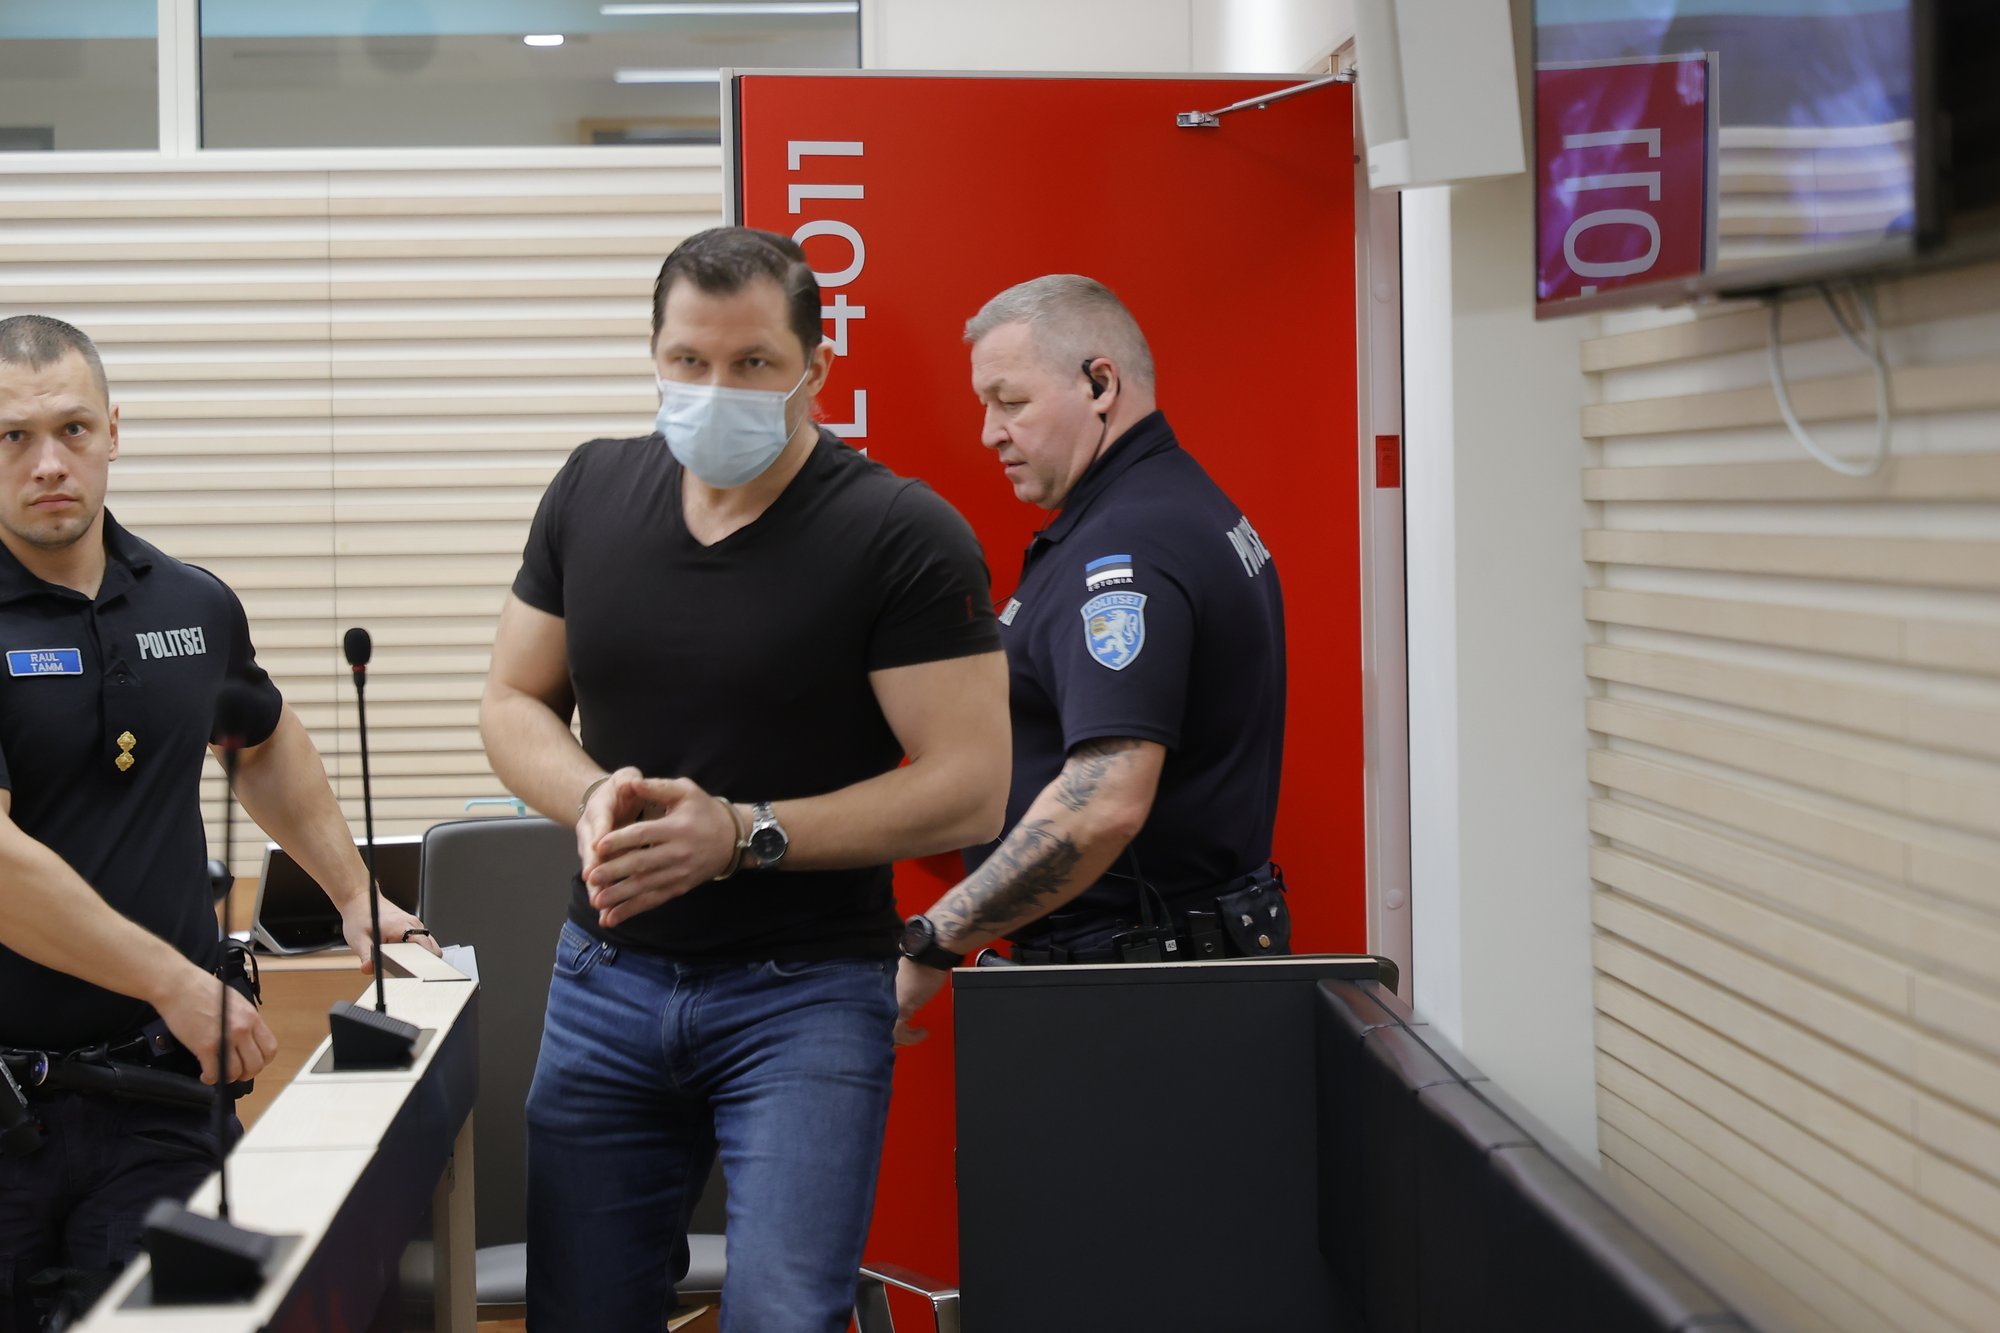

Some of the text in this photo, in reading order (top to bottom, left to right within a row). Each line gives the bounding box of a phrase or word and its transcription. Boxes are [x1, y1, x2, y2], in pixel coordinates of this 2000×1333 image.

[787, 140, 866, 356] 4011
[1087, 577, 1134, 592] ESTONIA
[1084, 594, 1139, 615] POLITSEI
[135, 626, 207, 660] POLITSEI
[30, 653, 59, 663] RAUL
[30, 663, 64, 672] TAMM
